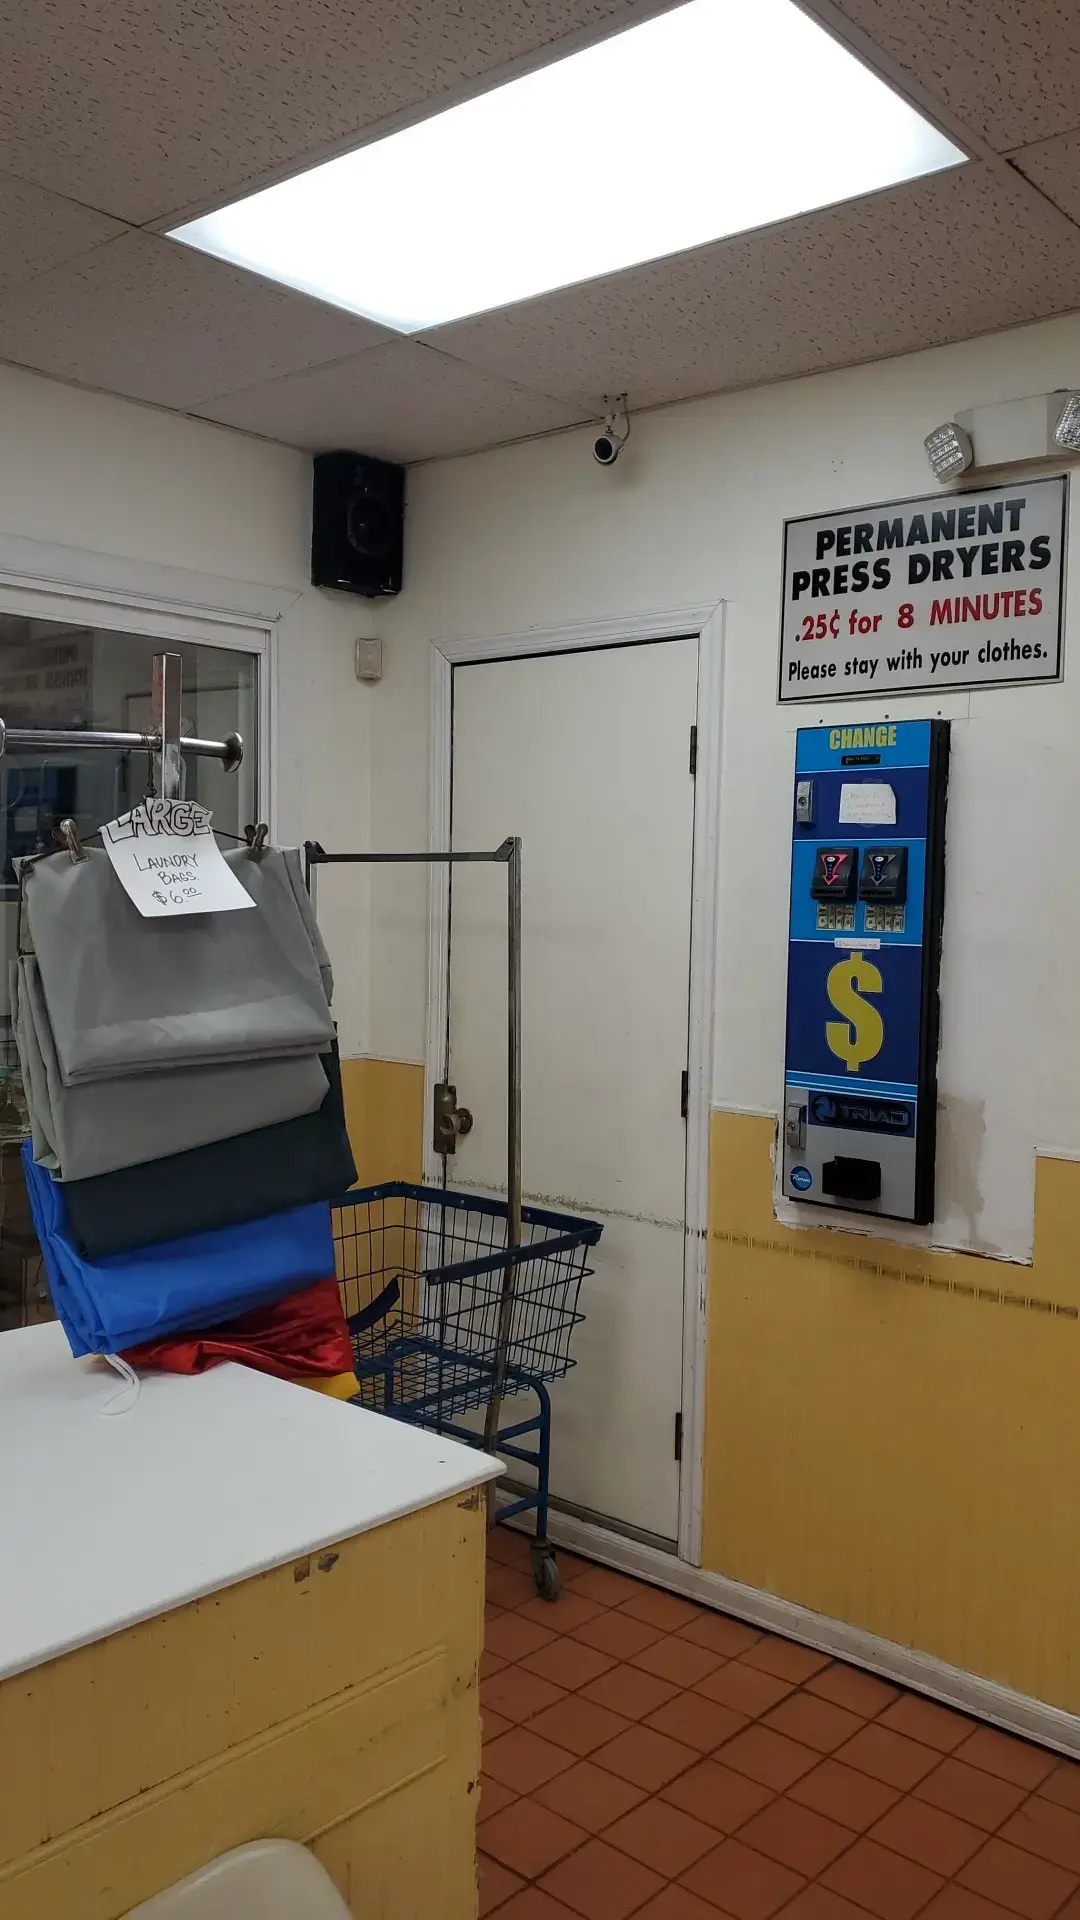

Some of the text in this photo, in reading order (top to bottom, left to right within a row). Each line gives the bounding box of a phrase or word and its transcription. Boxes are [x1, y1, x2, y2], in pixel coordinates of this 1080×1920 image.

[815, 498, 1026, 560] PERMANENT
[791, 535, 1051, 601] PRESS DRYERS
[795, 587, 1043, 642] .25¢ for 8 MINUTES
[788, 638, 1048, 681] Please stay with your clothes.
[828, 725, 897, 750] CHANGE
[105, 800, 211, 844] LARGE
[133, 853, 200, 871] LAUNDRY
[840, 1103, 909, 1126] TRIAD
